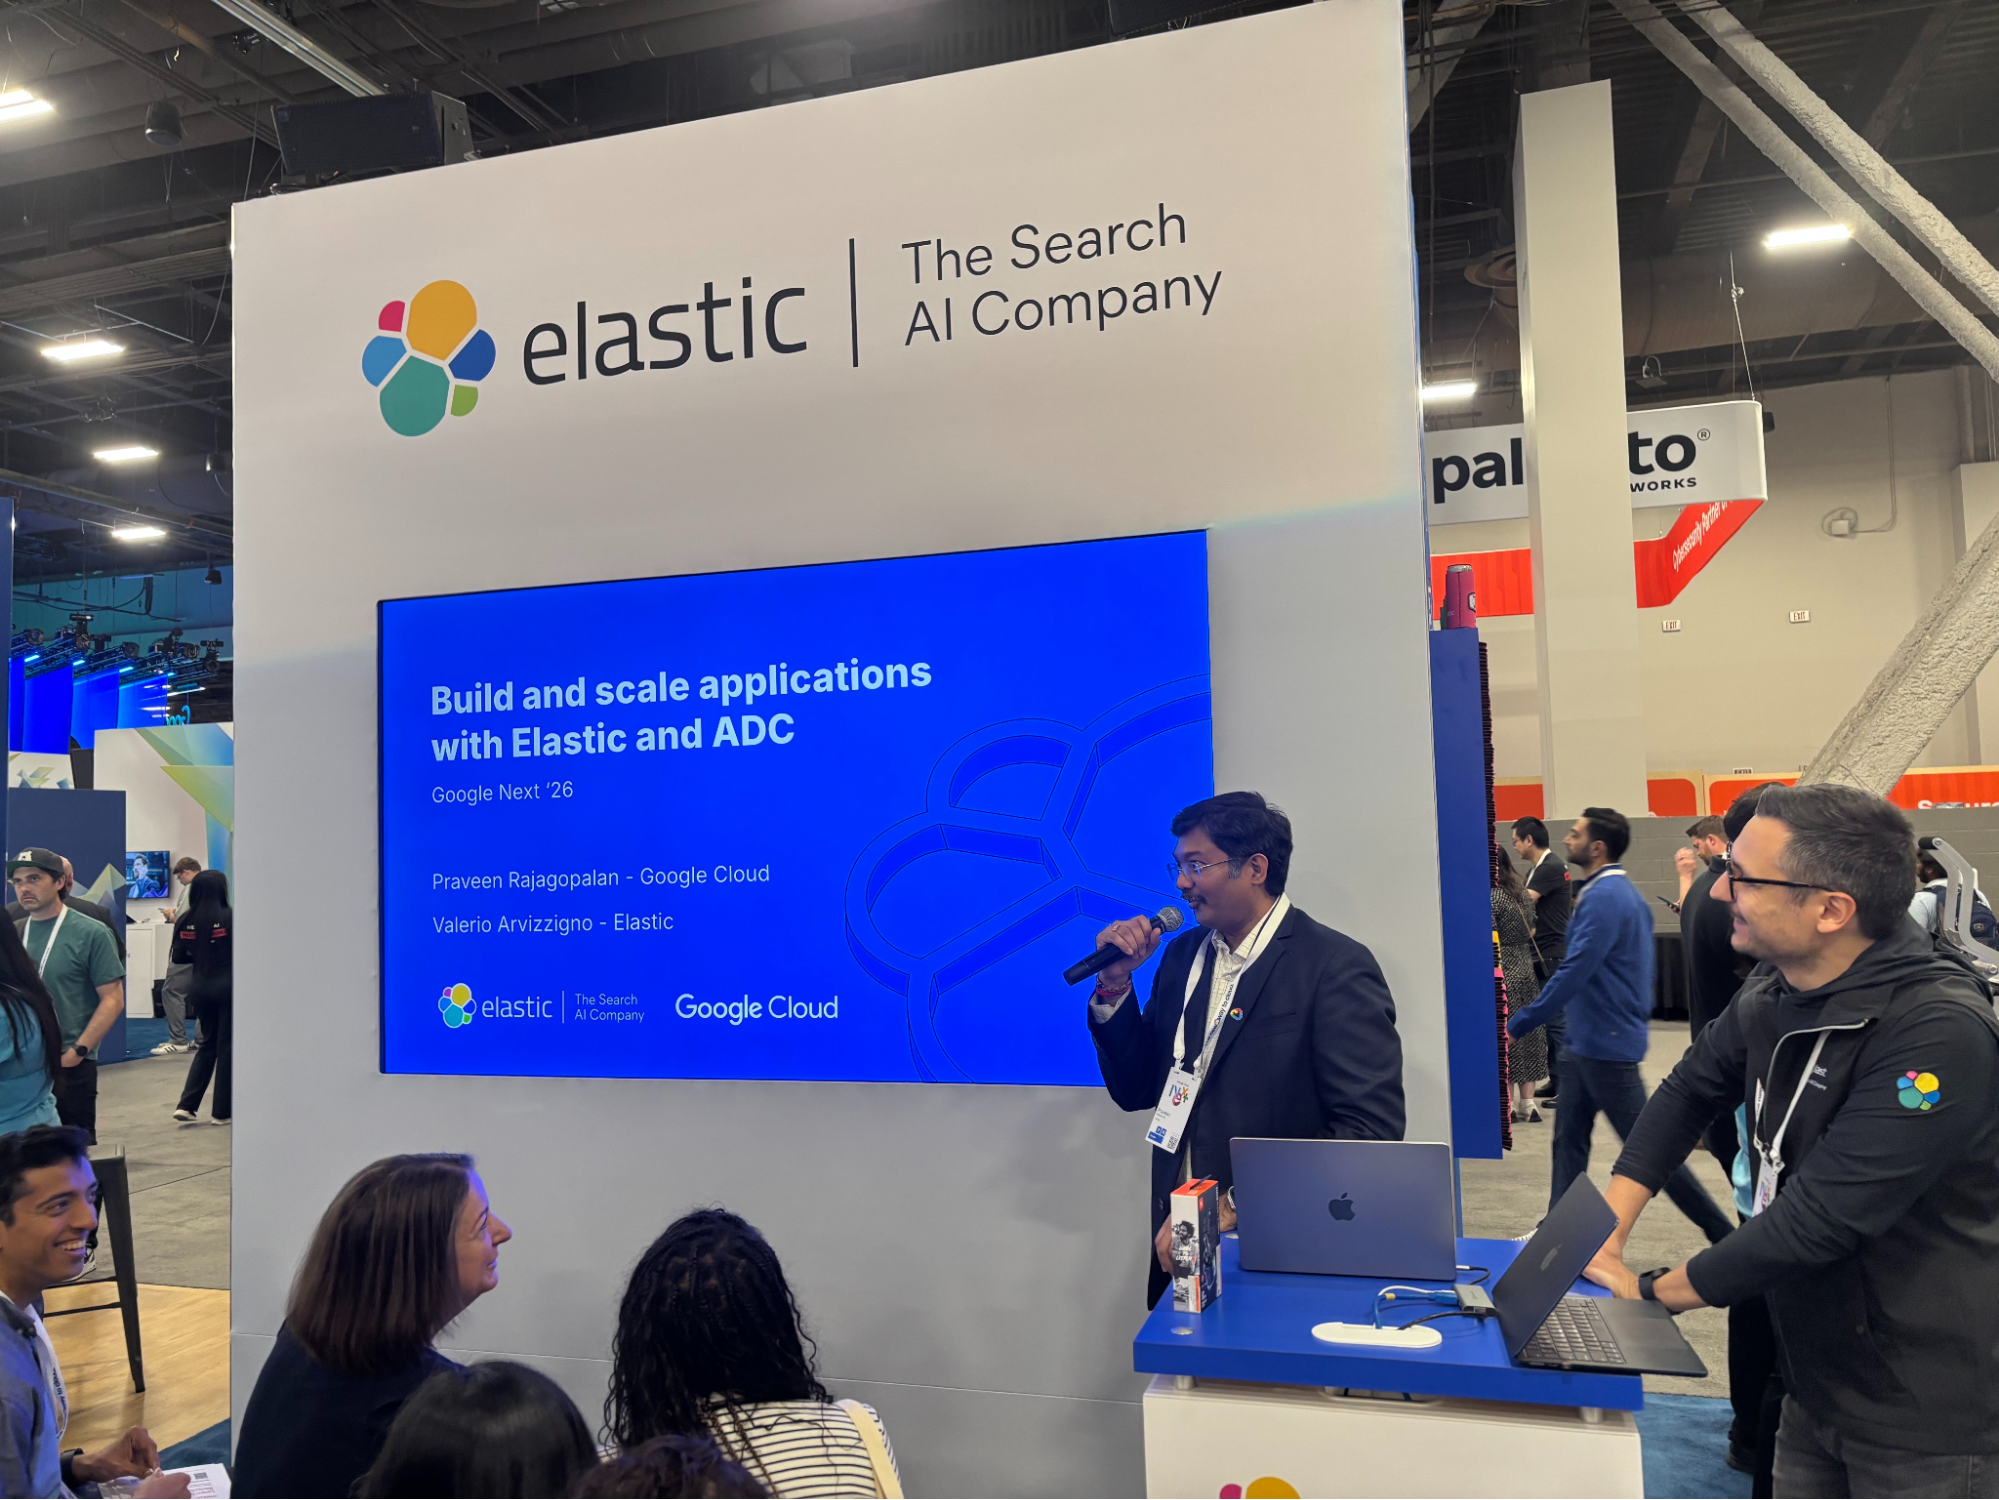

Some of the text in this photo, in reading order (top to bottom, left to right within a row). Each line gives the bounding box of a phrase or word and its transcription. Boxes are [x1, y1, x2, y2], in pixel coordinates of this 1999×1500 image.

[901, 202, 1186, 284] The Search
[904, 270, 1222, 346] AI Company
[523, 276, 807, 386] elastic
[1630, 477, 1698, 493] WORKS
[1673, 521, 1702, 573] Cybersecurity
[1665, 621, 1677, 630] EXIT
[1793, 611, 1806, 620] EXIT
[431, 657, 932, 716] Build and scale applications
[431, 712, 795, 762] with Elastic and ADC
[432, 784, 493, 806] Google
[499, 783, 540, 800] Next
[433, 873, 503, 890] Praveen
[508, 869, 619, 892] Rajagopalan
[640, 866, 708, 889] Google
[713, 864, 770, 883] Cloud
[432, 916, 493, 934] Valerio
[497, 914, 593, 936] Arvizzigno
[614, 912, 674, 931] Elastic
[481, 995, 553, 1018] elastic
[575, 993, 638, 1006] The Search
[675, 993, 839, 1026] Google Cloud
[575, 1009, 645, 1023] AI Company
